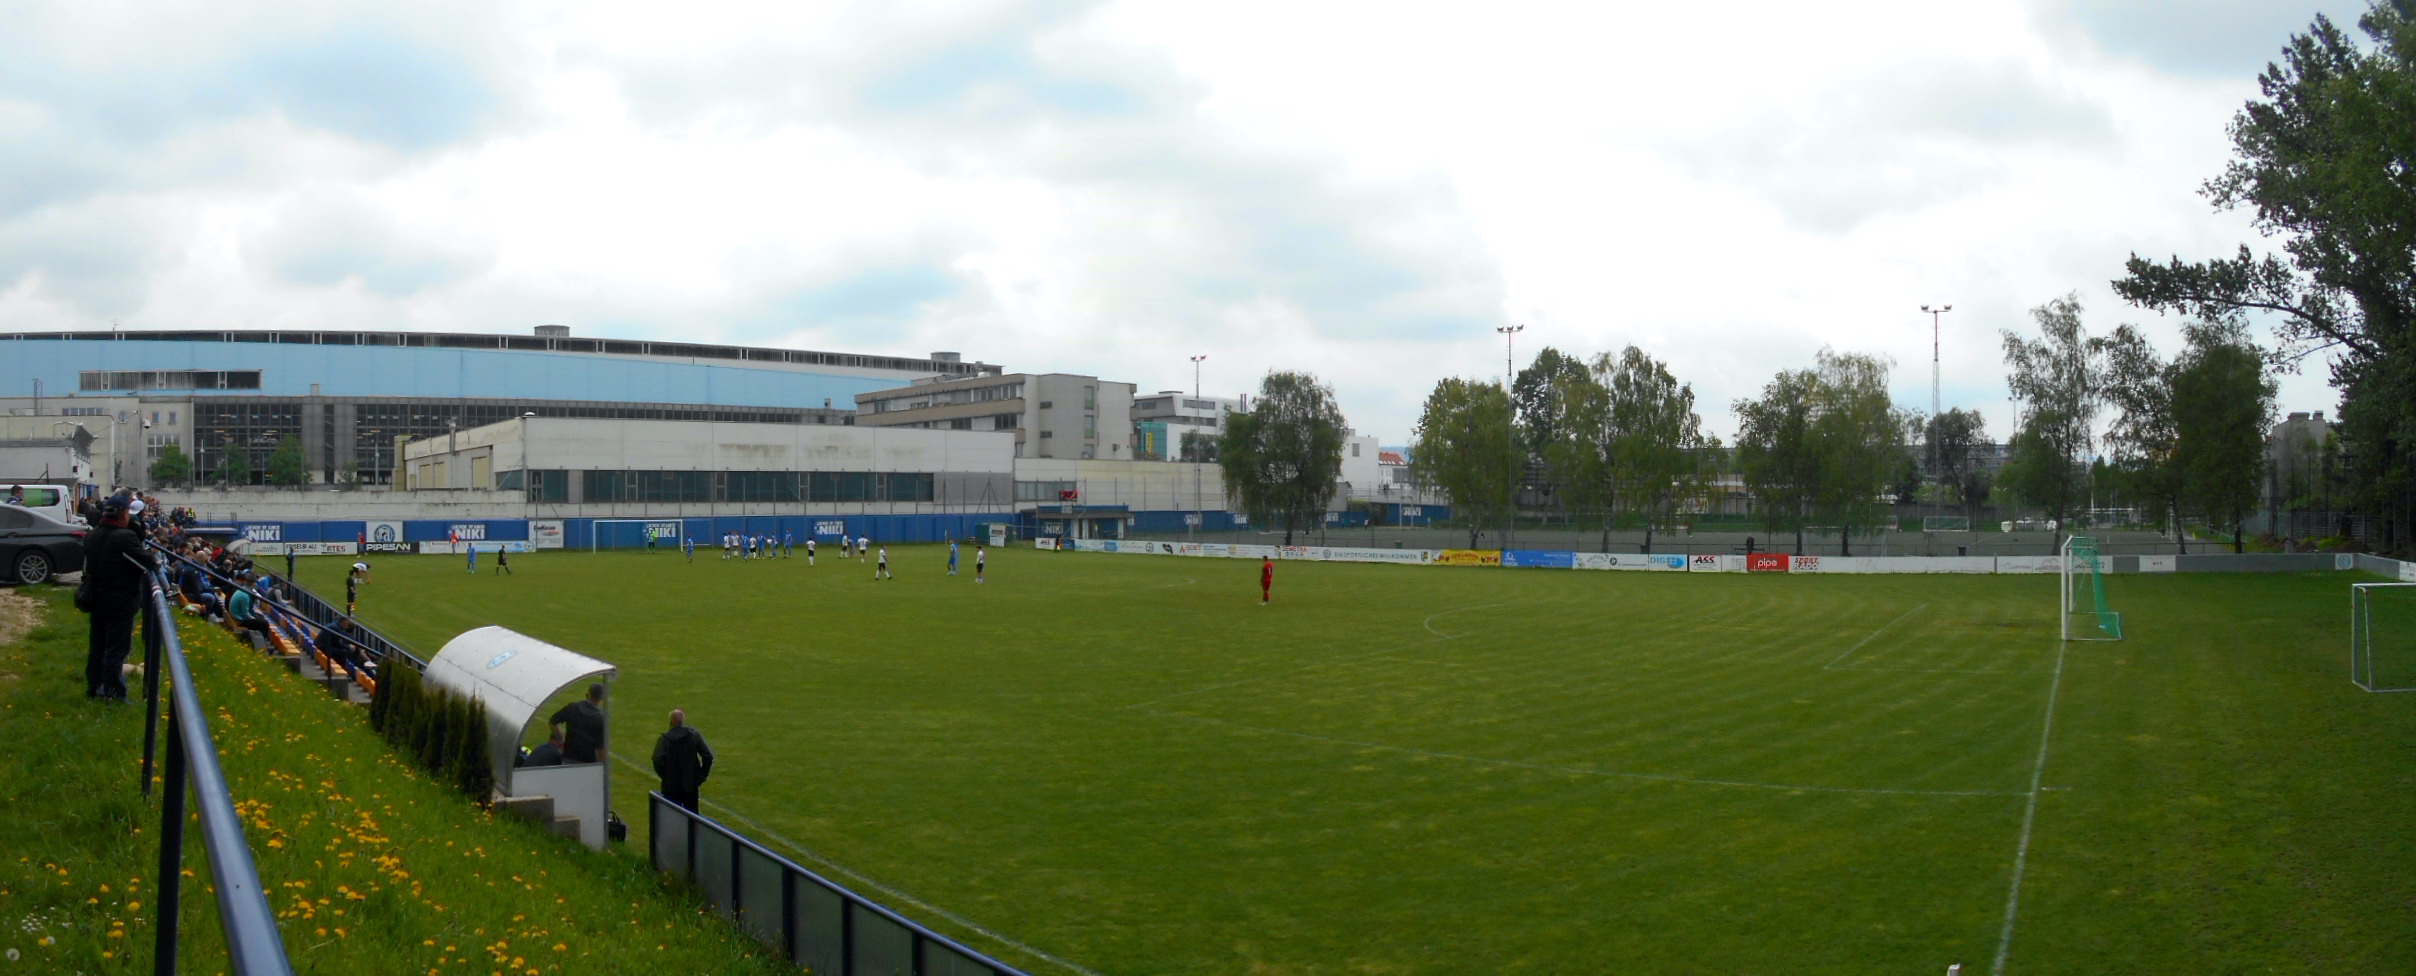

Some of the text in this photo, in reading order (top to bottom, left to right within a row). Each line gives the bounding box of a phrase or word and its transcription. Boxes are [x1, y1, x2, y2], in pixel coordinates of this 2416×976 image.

[248, 530, 280, 541] NIKI
[366, 543, 411, 551] PIPESAN
[1695, 556, 1715, 564] ASS
